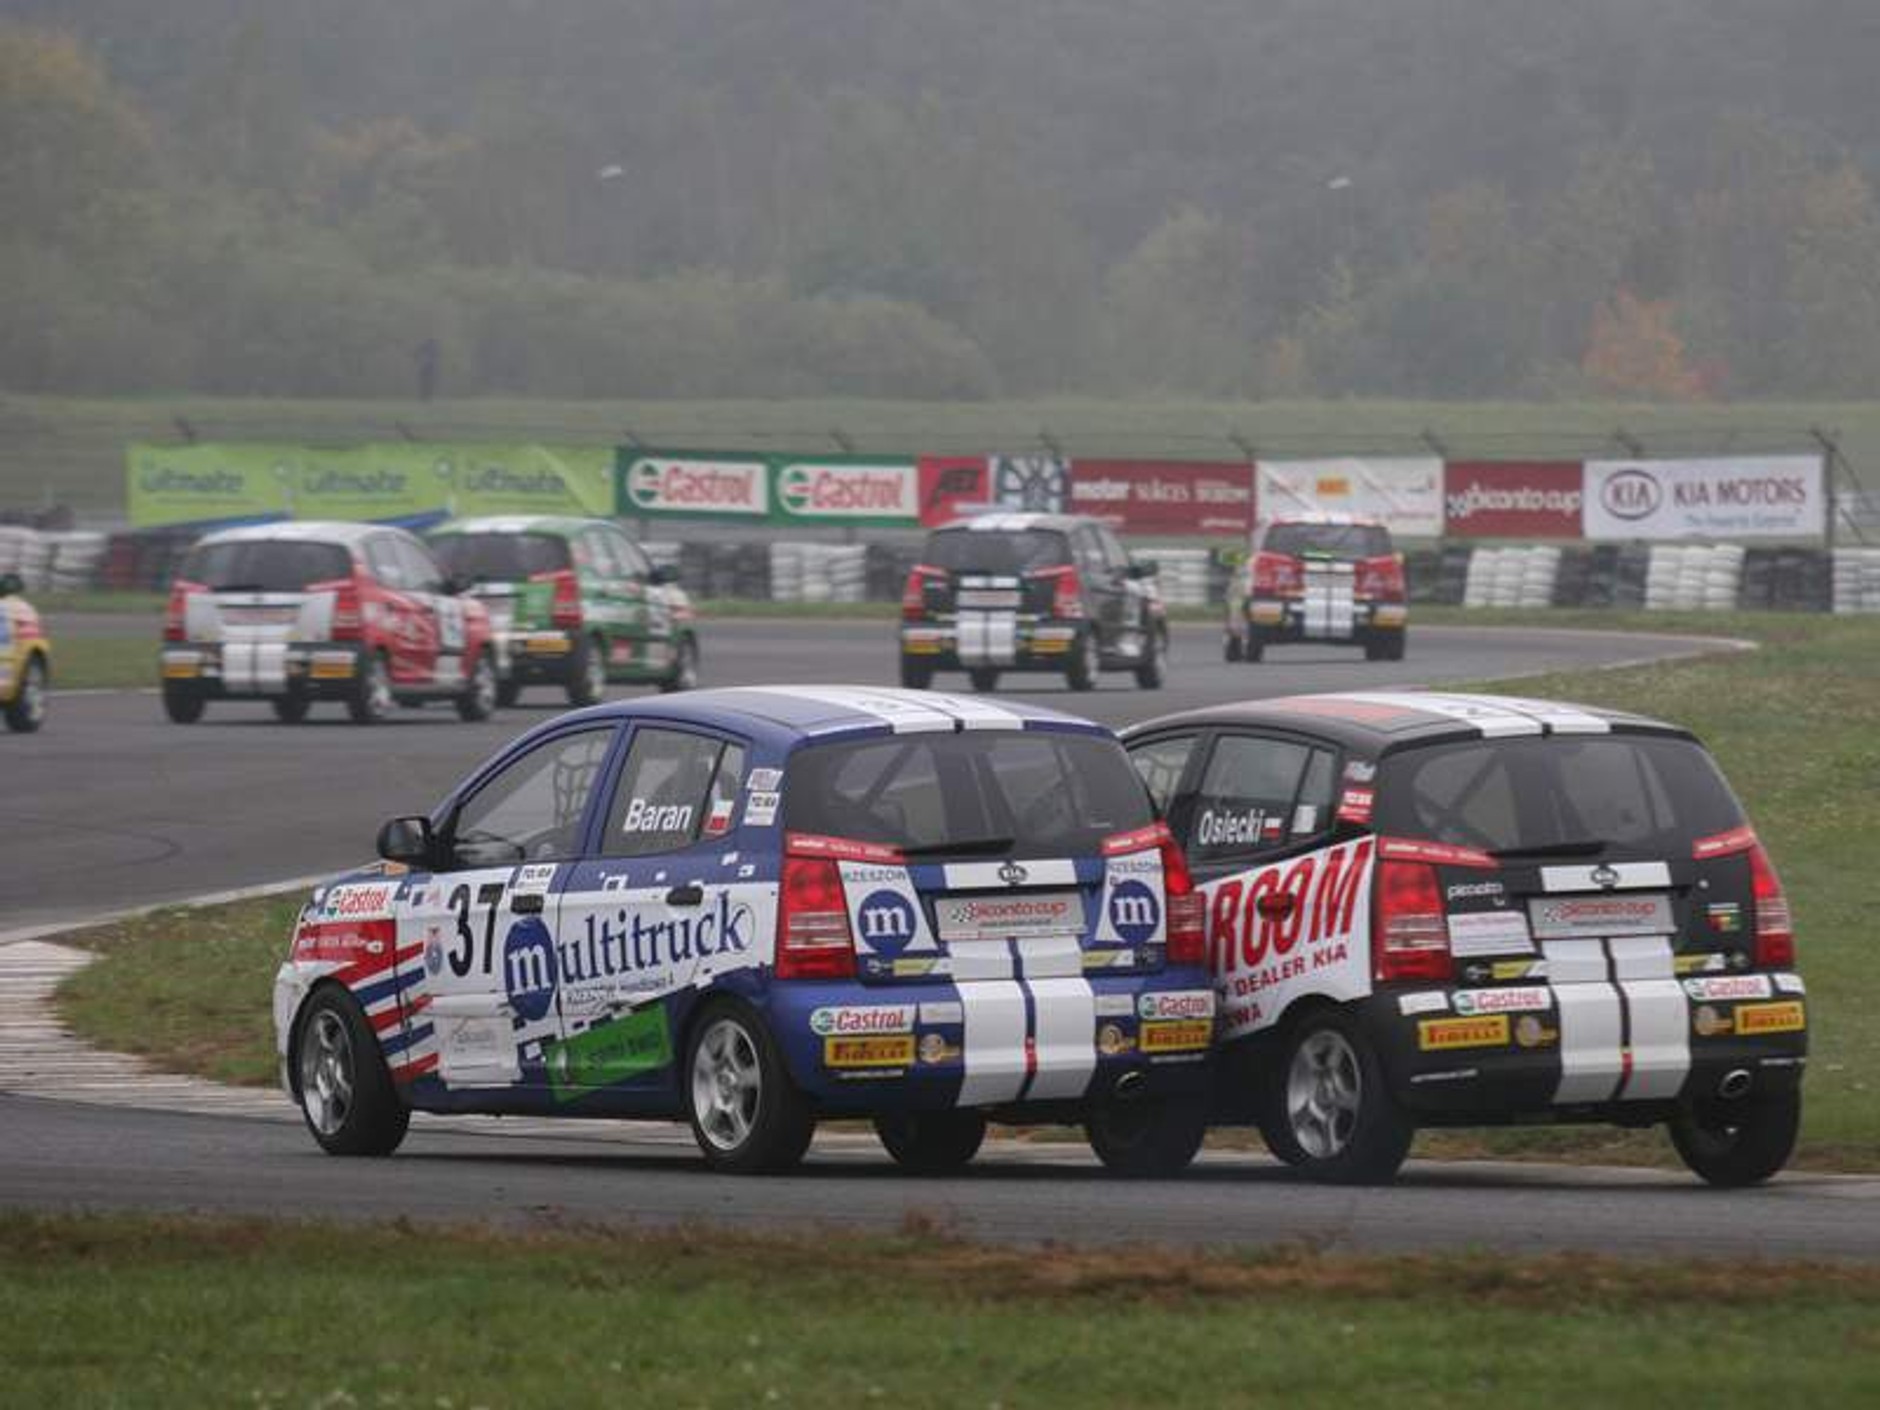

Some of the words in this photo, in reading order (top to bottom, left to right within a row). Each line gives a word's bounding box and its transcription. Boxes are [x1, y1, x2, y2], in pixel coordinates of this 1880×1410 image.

[663, 466, 755, 504] Castrol
[812, 470, 903, 508] Castrol
[1611, 481, 1651, 506] KIA
[1674, 480, 1710, 506] KIA
[1716, 476, 1806, 506] MOTORS
[623, 799, 693, 832] Baran
[1198, 810, 1264, 846] Osiecki
[864, 907, 910, 936] m
[1114, 897, 1155, 925] m
[1207, 841, 1374, 978] ROOM
[448, 884, 504, 977] 37
[1234, 956, 1306, 996] DEALER
[1313, 943, 1347, 968] KIA
[1158, 996, 1208, 1016] Castrol
[1477, 989, 1542, 1010] Castrol
[836, 1009, 905, 1031] Castrol
